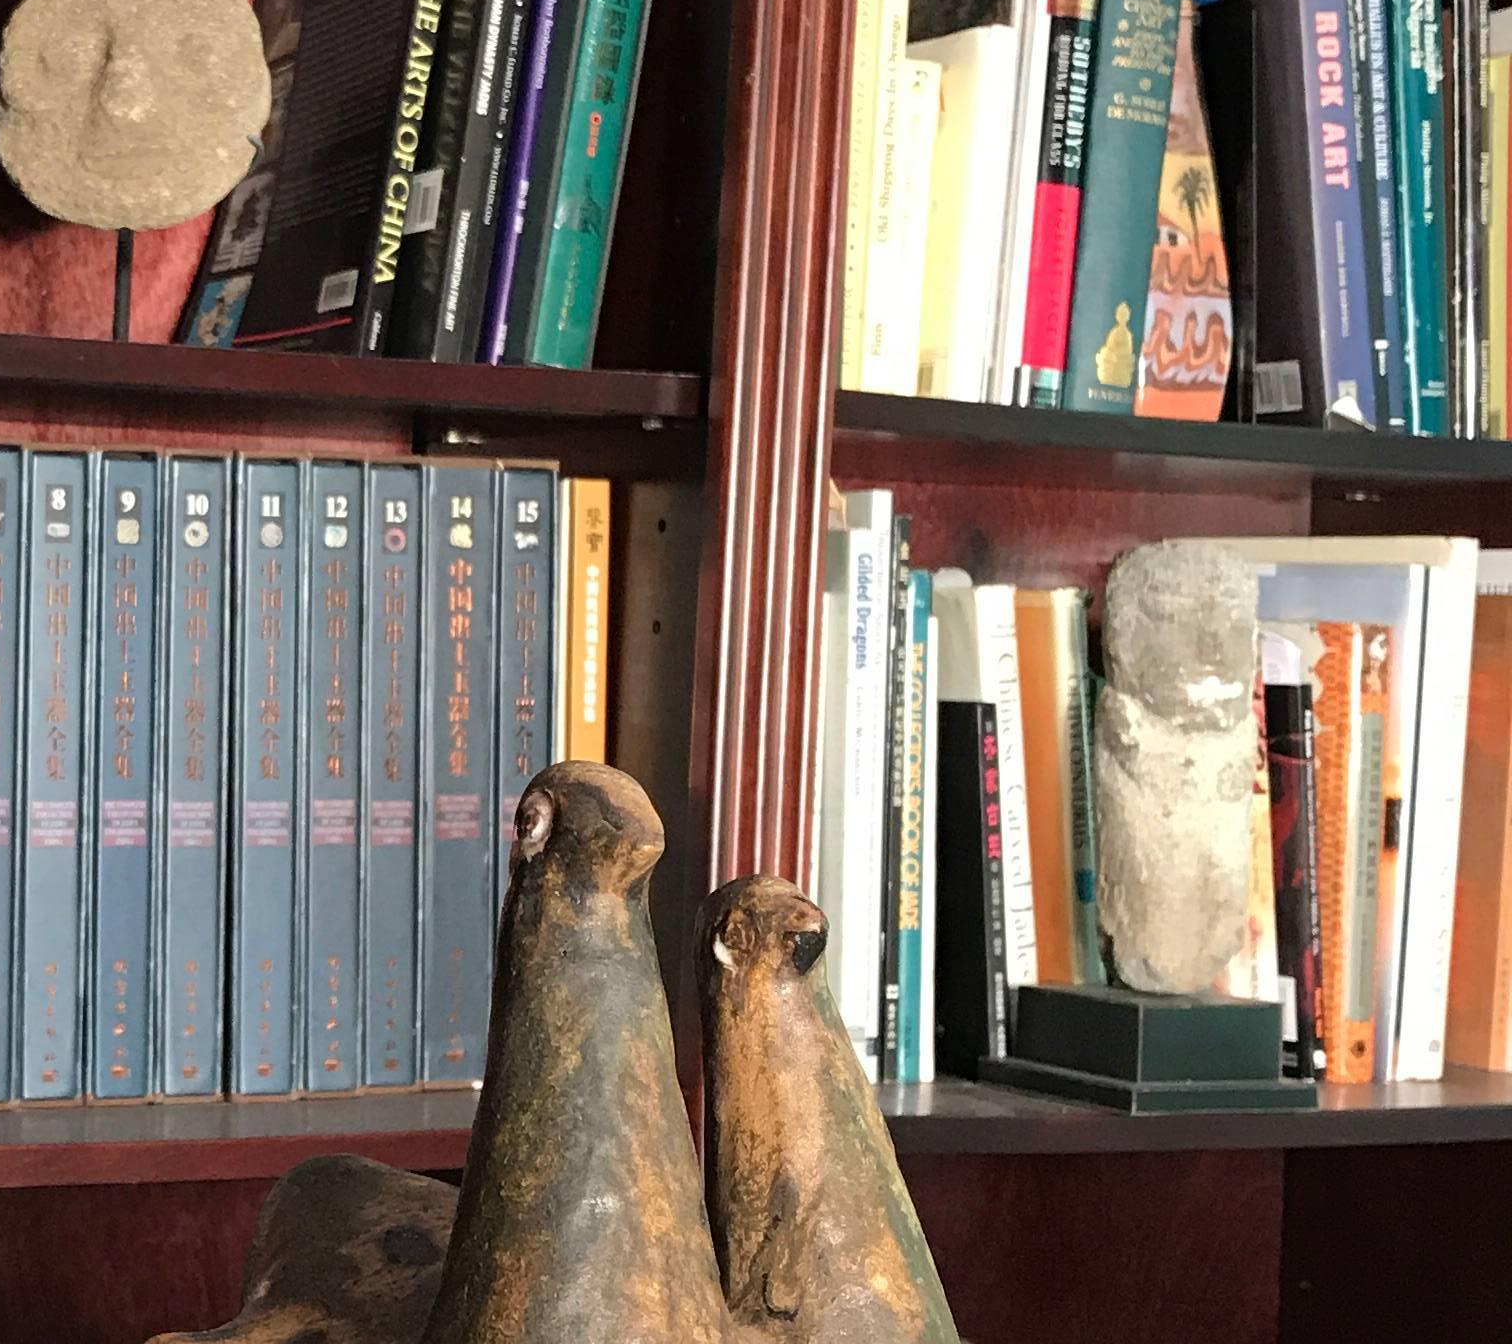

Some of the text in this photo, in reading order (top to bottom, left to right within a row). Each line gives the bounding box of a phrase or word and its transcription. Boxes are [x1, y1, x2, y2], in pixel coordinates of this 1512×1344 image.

[479, 24, 499, 79] DYNASTY
[1315, 10, 1344, 108] ROCK
[399, 33, 436, 121] ARTS
[474, 77, 491, 116] JADES
[391, 122, 420, 172] OF
[1048, 122, 1064, 167] CLASS
[1321, 122, 1351, 190] ART
[372, 172, 411, 286] CHINA
[442, 208, 472, 331] THROCKMORTON FINE ART
[50, 487, 66, 511] 8
[120, 490, 136, 512] 9
[184, 494, 210, 516] 10
[261, 495, 282, 517] 11
[324, 497, 348, 518] 12
[384, 500, 408, 523] 13
[450, 497, 474, 519] 14
[517, 501, 540, 523] 15
[851, 551, 874, 669] Gilded Dragons
[901, 794, 922, 856] BOOK
[900, 858, 920, 887] OF
[899, 890, 920, 930] JADE
